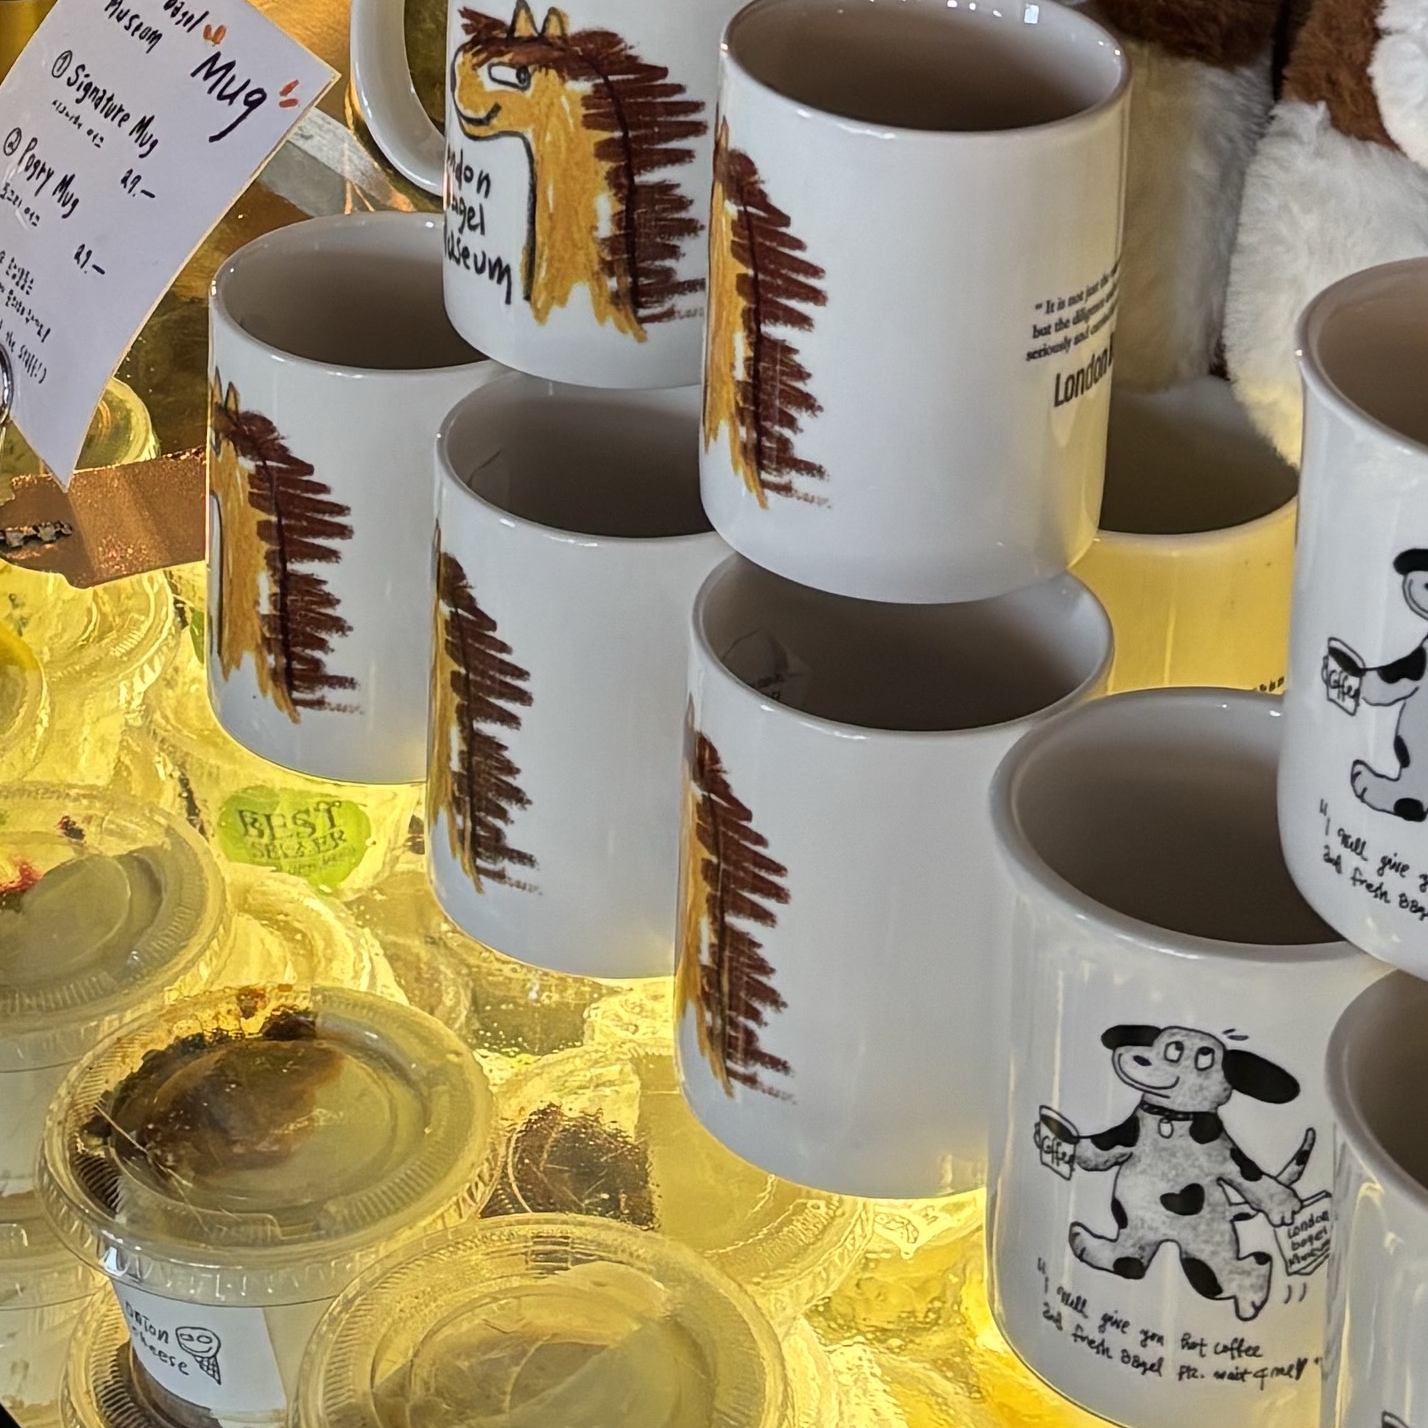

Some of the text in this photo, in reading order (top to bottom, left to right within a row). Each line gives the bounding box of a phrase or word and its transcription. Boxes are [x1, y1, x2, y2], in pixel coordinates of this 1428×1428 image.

[67, 63, 131, 129] Signature
[128, 114, 159, 159] Mug
[190, 50, 269, 143] Mug
[52, 173, 80, 219] Mug
[444, 228, 513, 306] useum
[1054, 347, 1109, 408] London
